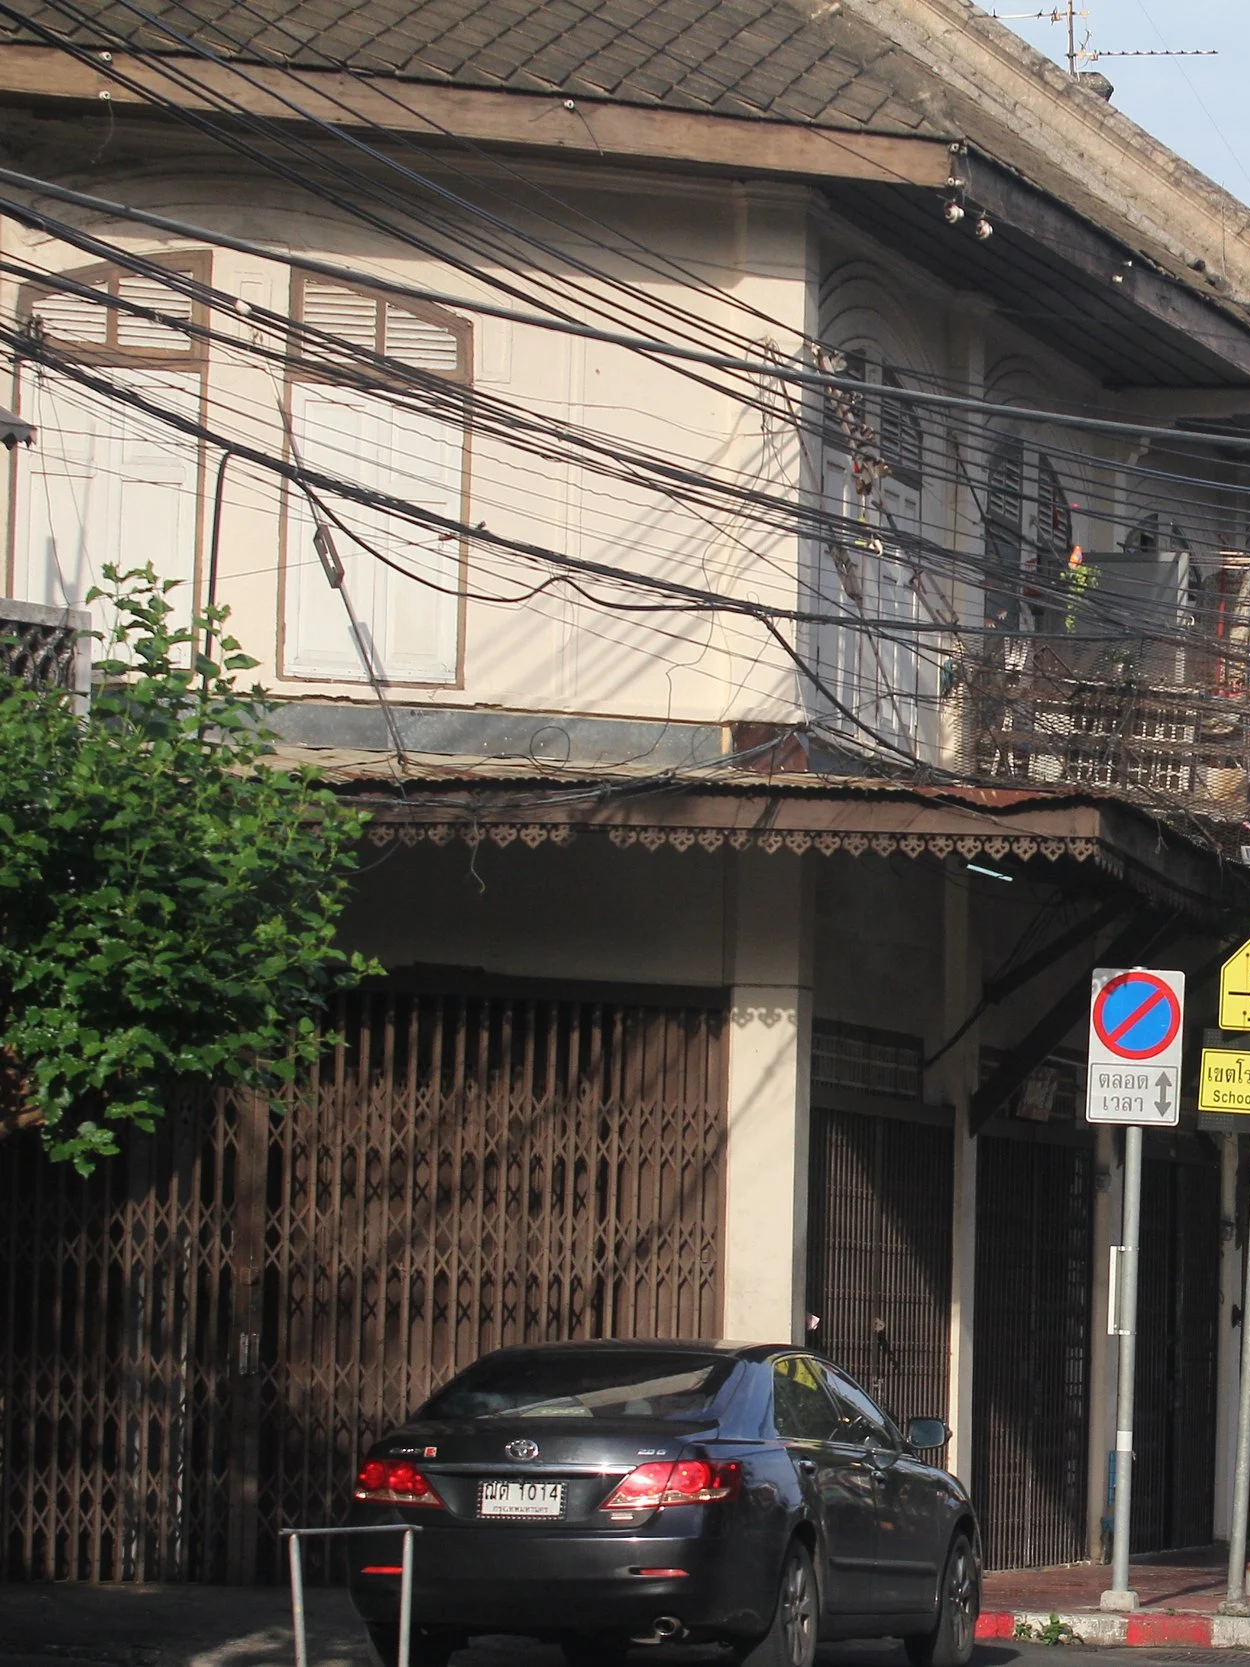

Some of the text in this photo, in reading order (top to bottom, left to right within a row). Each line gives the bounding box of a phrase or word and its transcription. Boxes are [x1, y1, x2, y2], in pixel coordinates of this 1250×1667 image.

[1099, 1073, 1148, 1089] ตลอด
[1103, 1096, 1144, 1112] เวลา
[519, 1484, 558, 1501] 1014
